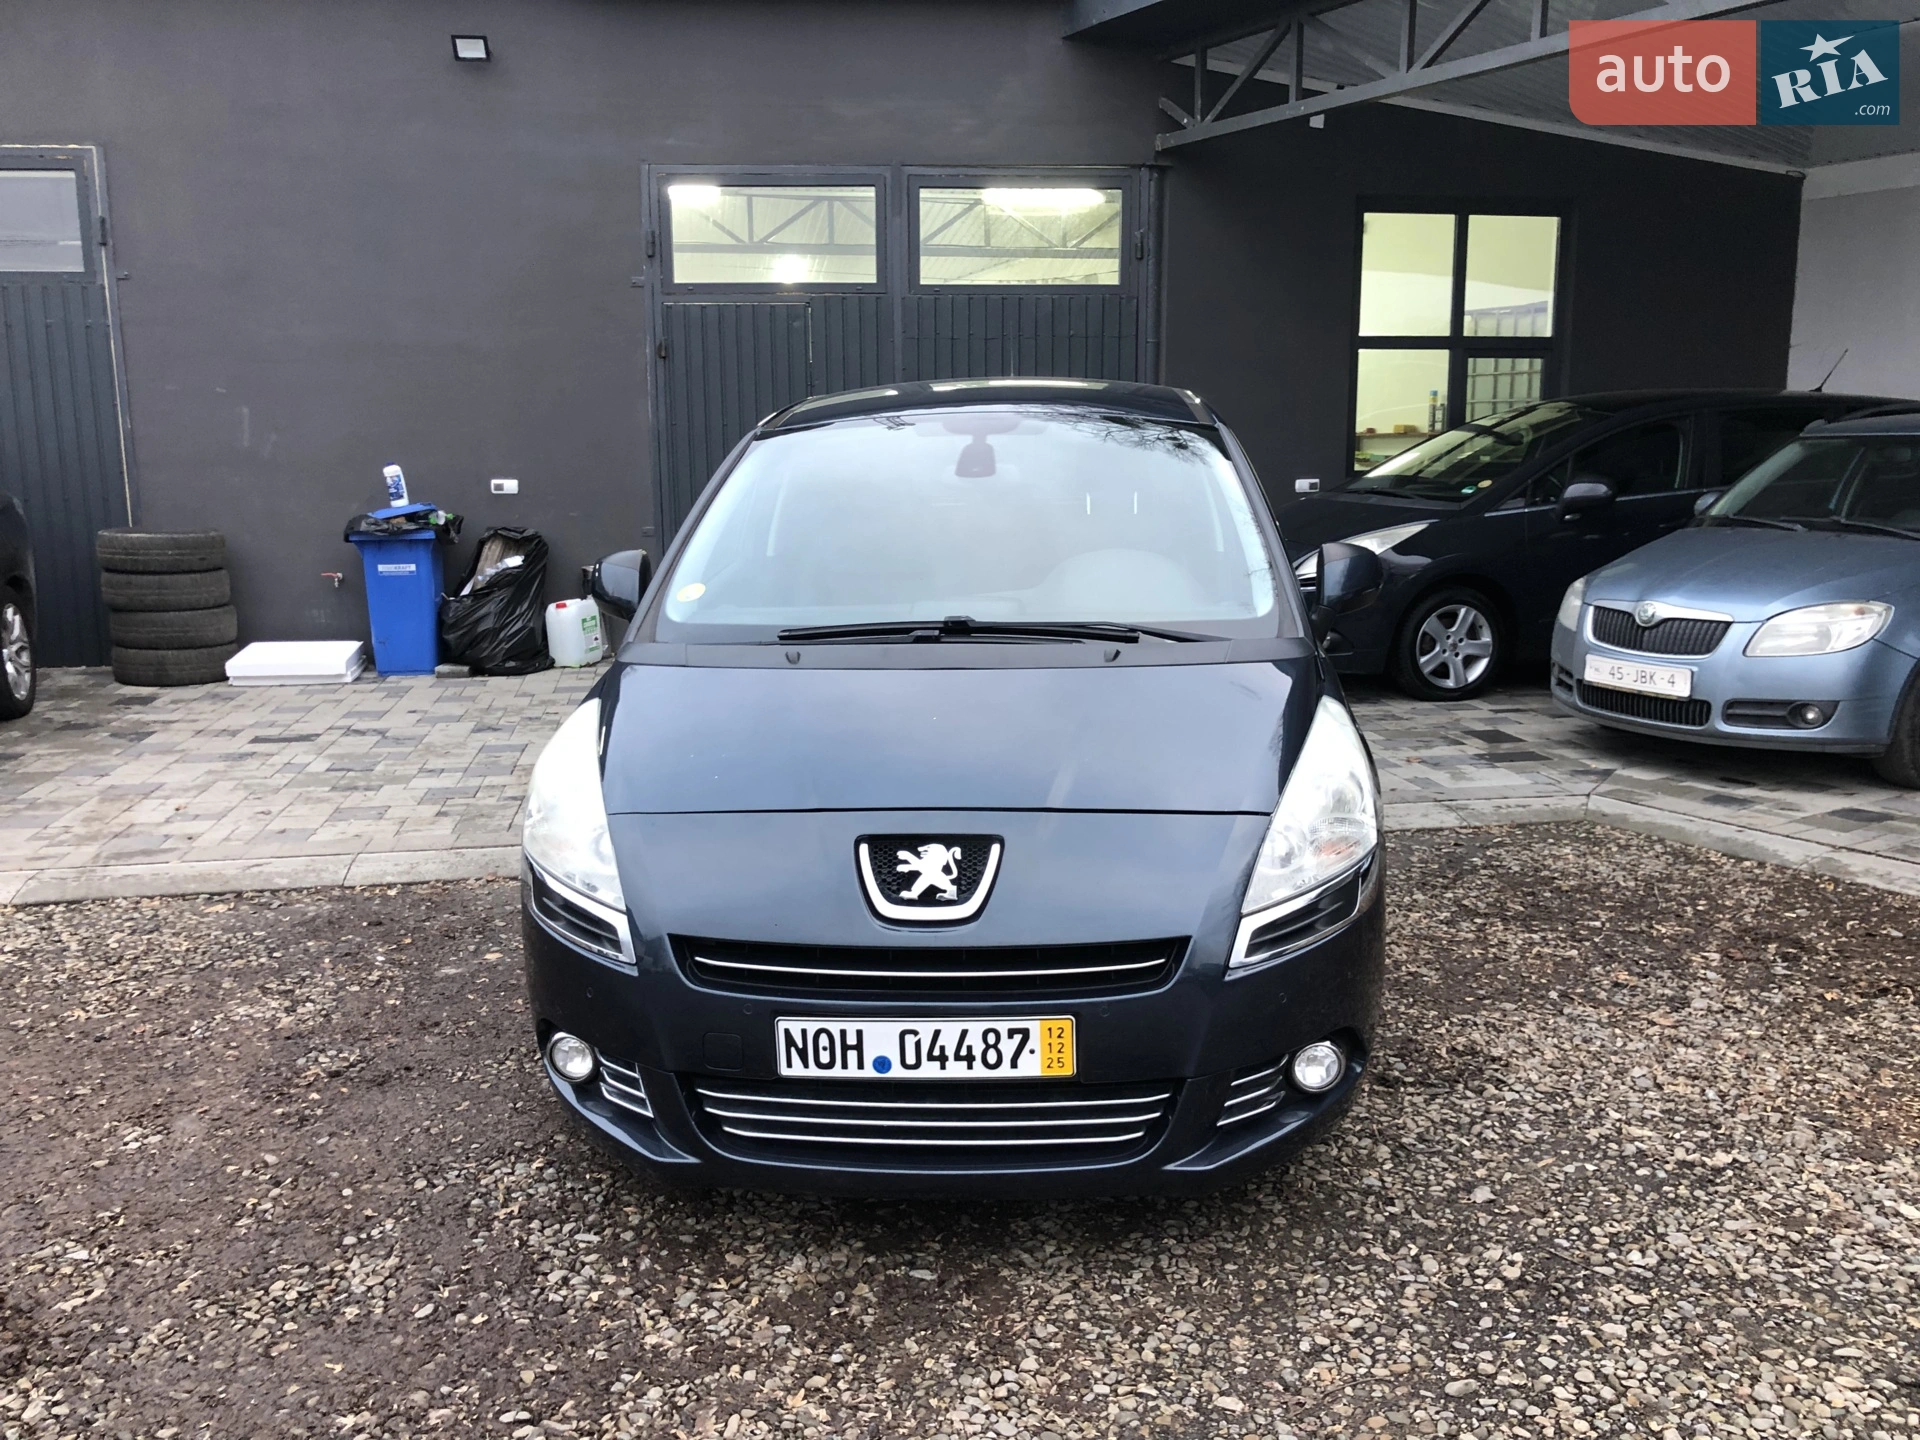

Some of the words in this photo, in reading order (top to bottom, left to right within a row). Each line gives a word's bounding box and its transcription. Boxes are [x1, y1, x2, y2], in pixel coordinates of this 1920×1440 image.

[1047, 1026, 1065, 1039] 12
[784, 1028, 865, 1071] NOH
[898, 1027, 1031, 1071] 04487
[1047, 1042, 1065, 1054] 12
[1046, 1056, 1065, 1069] 25
